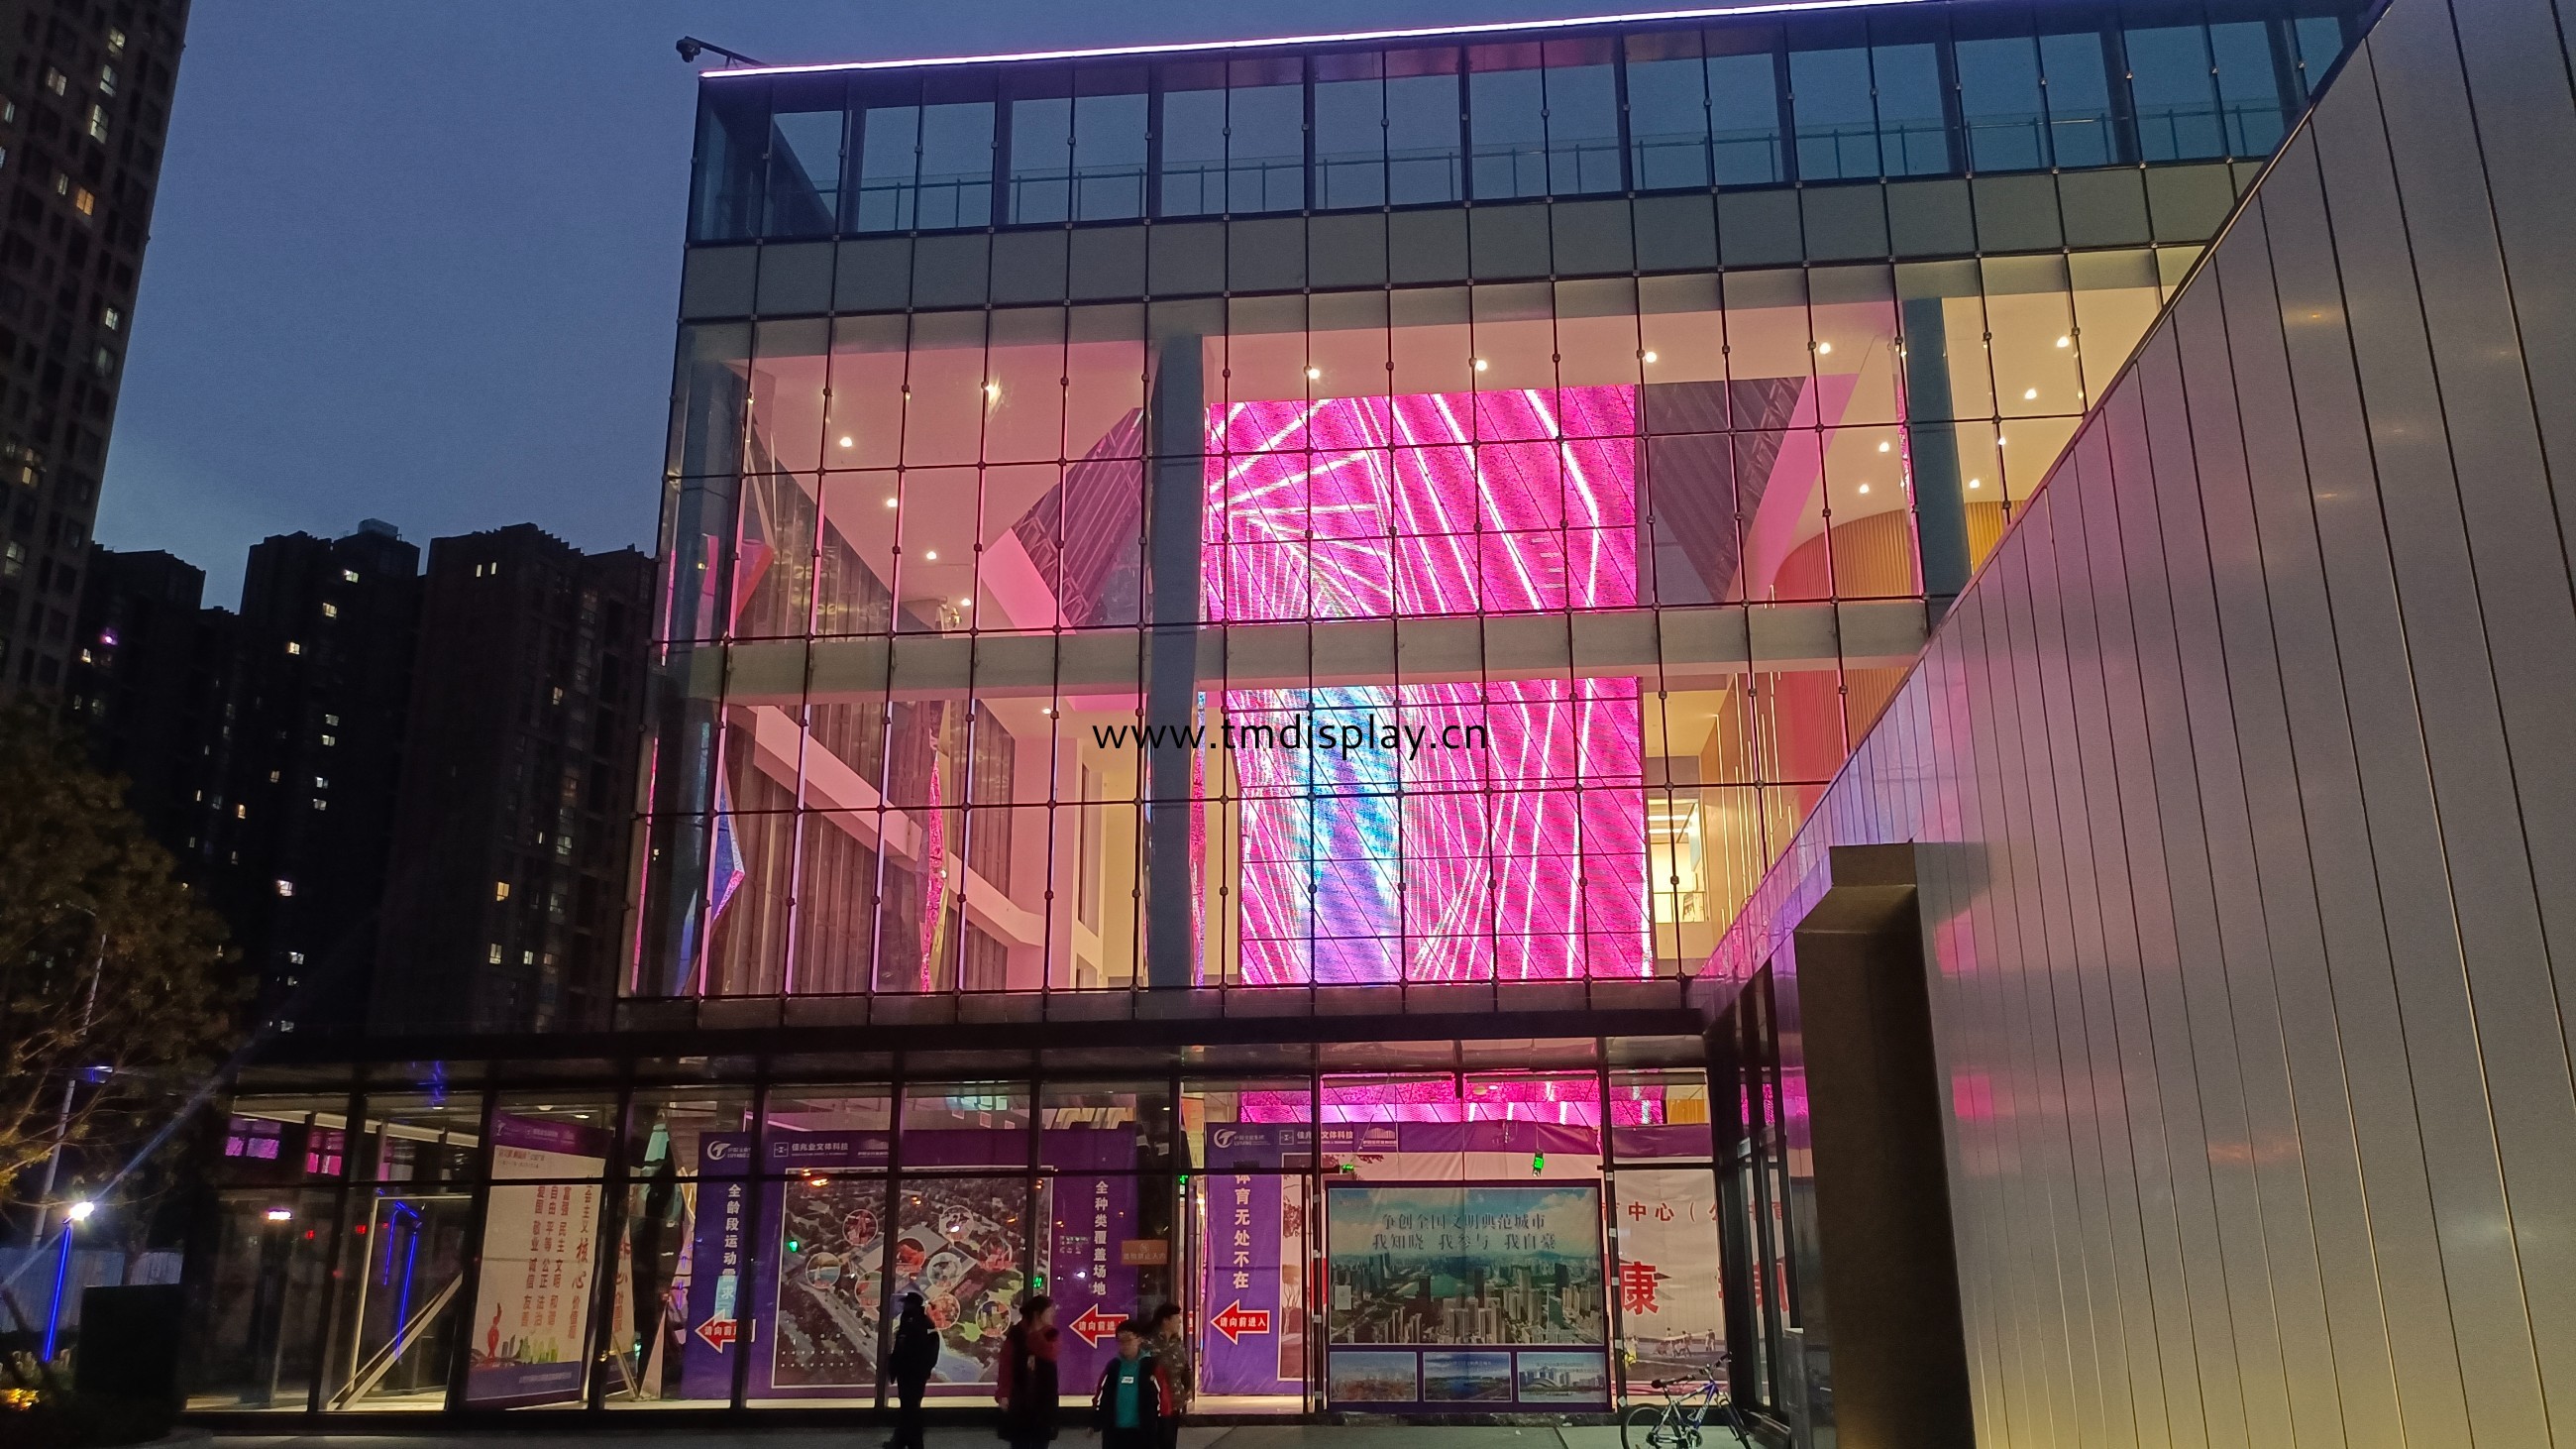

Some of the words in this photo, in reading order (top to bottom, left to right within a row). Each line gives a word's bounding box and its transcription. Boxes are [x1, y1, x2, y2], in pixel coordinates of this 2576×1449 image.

[1297, 1131, 1353, 1140] 佳兆文体科技
[1382, 1213, 1546, 1230] 争创全国文明典范城市
[1092, 1180, 1109, 1296] 全种类覆盖场地
[1373, 1235, 1425, 1250] 我知晓
[1439, 1234, 1489, 1250] 我参与
[1504, 1234, 1556, 1250] 我自豪
[568, 1175, 593, 1339] 会主义核心价值观
[1078, 1320, 1121, 1331] 请向前进
[1220, 1316, 1267, 1327] 请向前进入
[704, 1325, 736, 1336] 请向前
